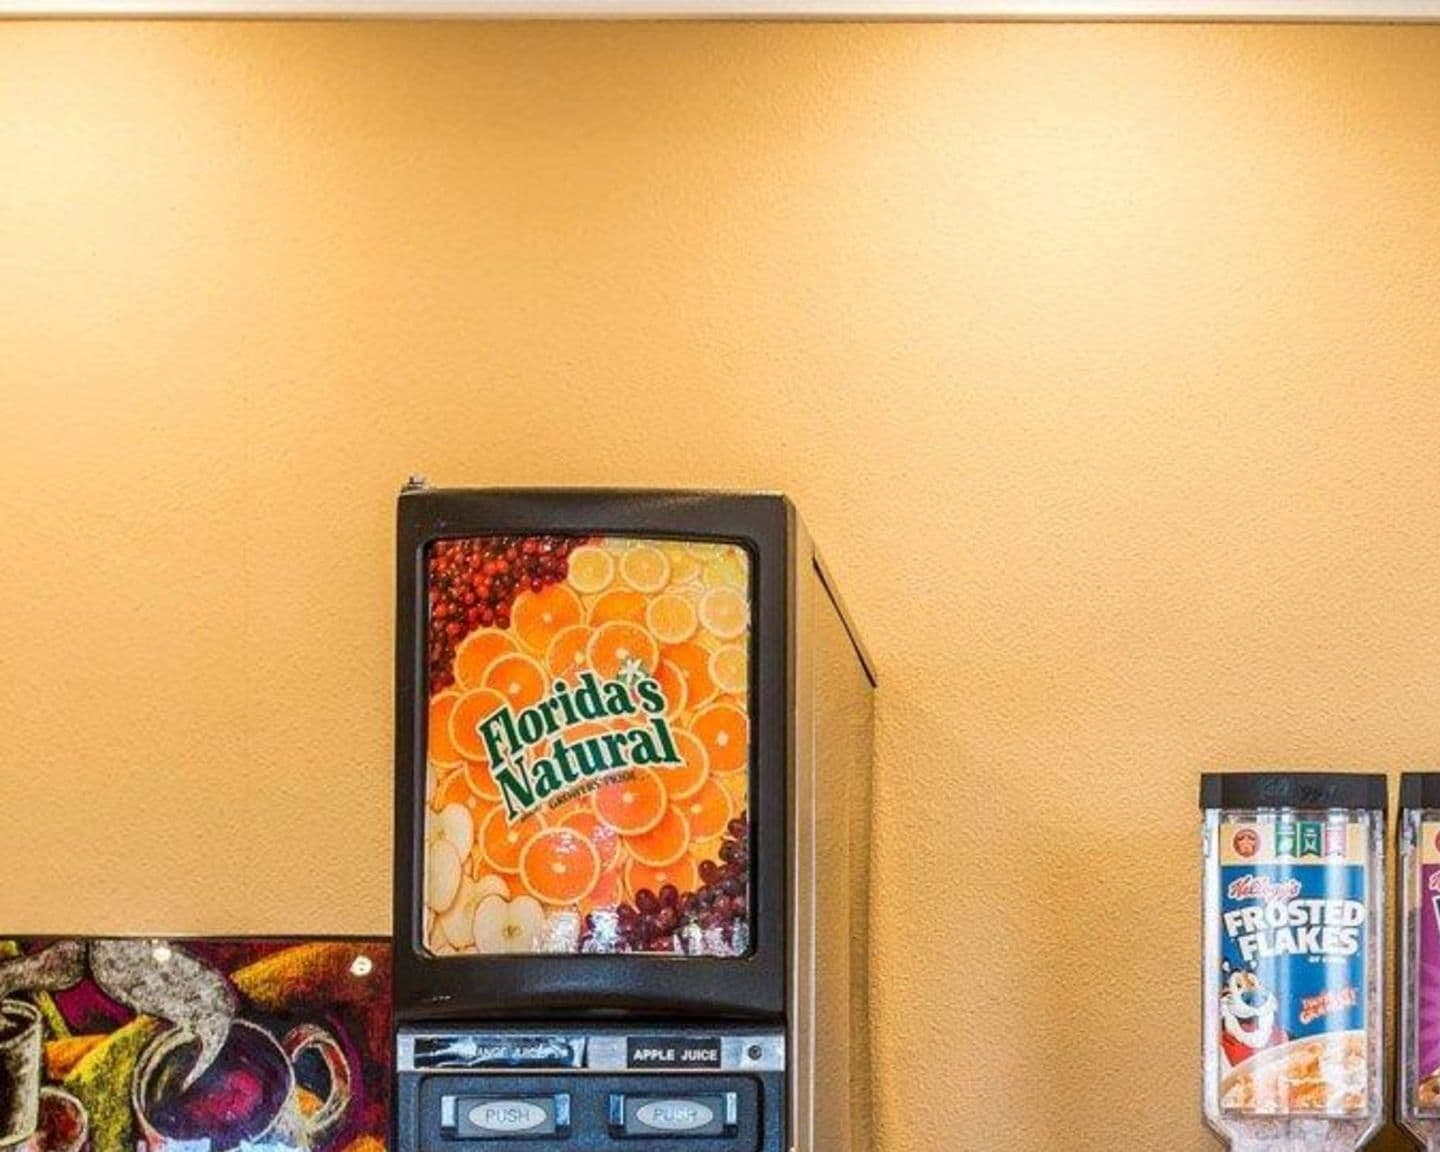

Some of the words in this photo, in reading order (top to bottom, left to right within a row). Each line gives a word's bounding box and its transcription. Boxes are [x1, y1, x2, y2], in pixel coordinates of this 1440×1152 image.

[479, 671, 665, 770] Florida's
[495, 717, 681, 821] Natural
[1223, 899, 1365, 937] FROSTED
[1238, 926, 1358, 961] FLAKES
[633, 1048, 674, 1061] APPLE
[681, 1048, 717, 1061] JUICE
[486, 1107, 530, 1123] PUSH
[654, 1107, 697, 1123] PUSH
